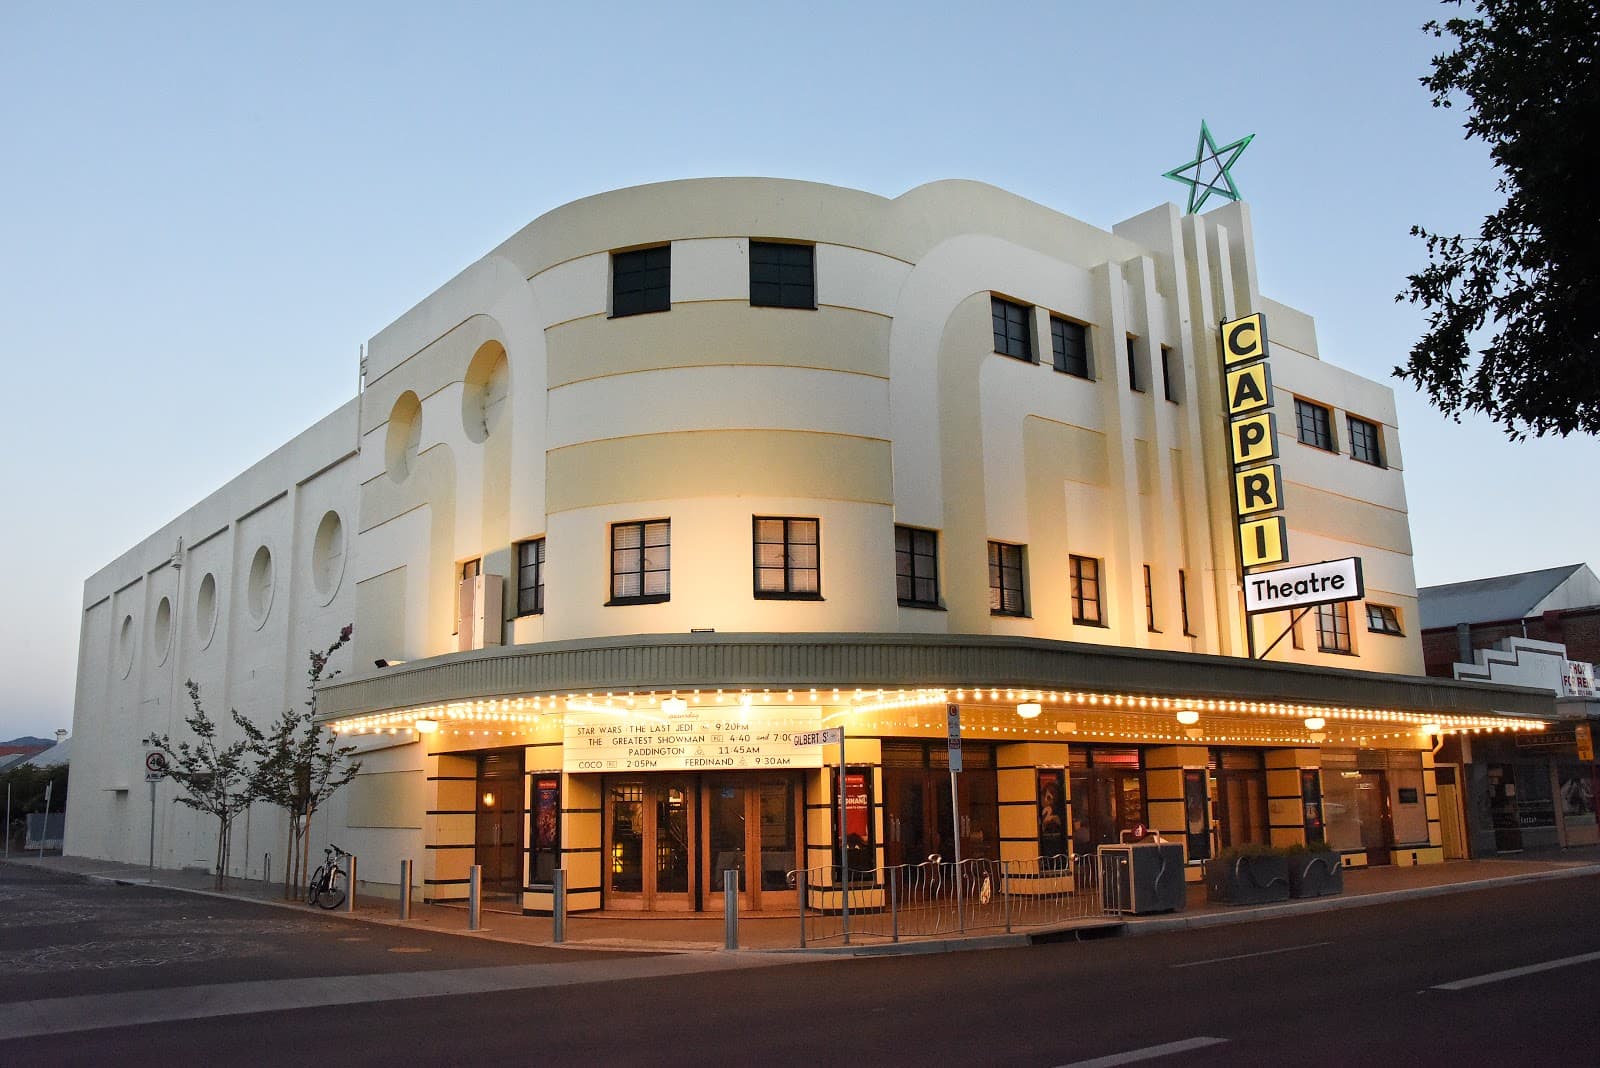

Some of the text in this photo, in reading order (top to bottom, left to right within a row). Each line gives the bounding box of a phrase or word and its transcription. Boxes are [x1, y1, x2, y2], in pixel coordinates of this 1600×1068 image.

[1227, 321, 1273, 559] CAPRI
[1251, 572, 1345, 602] Theatre
[577, 727, 595, 736] STAR
[629, 725, 646, 733] THE
[650, 724, 671, 733] LAST
[675, 723, 693, 732] JEDI
[588, 738, 603, 746] THE
[612, 736, 653, 745] GREATEST
[657, 735, 705, 744] SHOWMAN
[793, 732, 819, 746] GILBERT
[628, 747, 685, 756] PADDINGTON
[578, 761, 603, 769] COCO
[684, 758, 734, 766] FERDINAND
